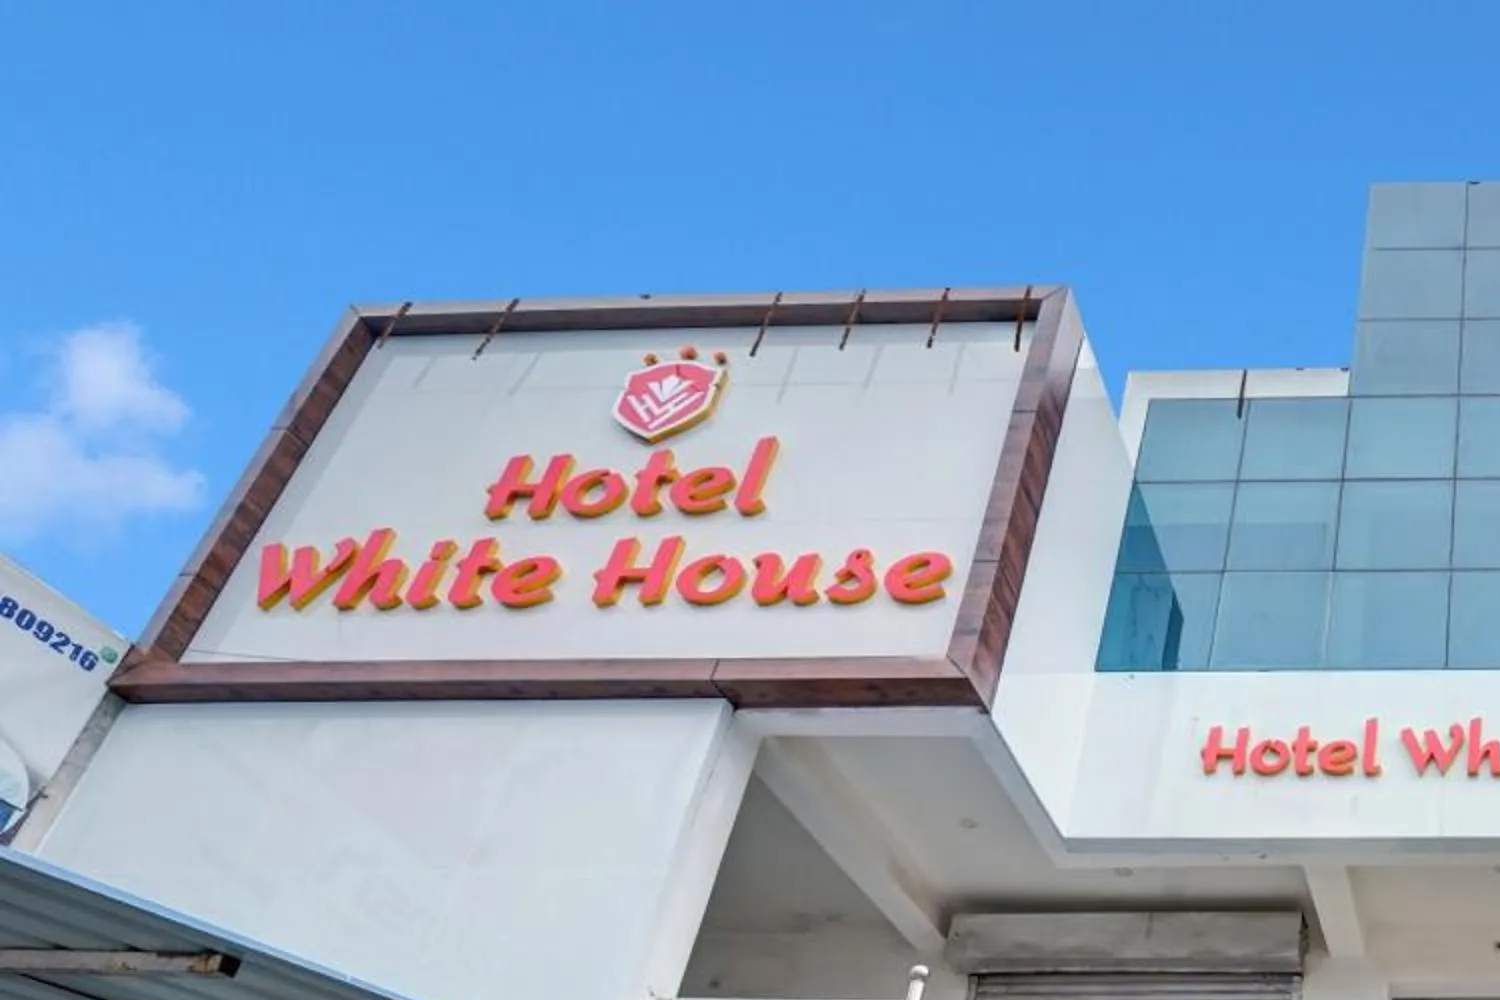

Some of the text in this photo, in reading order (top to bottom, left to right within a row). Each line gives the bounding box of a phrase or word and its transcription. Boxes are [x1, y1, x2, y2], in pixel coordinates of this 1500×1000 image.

[484, 436, 781, 520] Hotel
[257, 527, 953, 611] White House
[1200, 717, 1382, 777] Hotel
